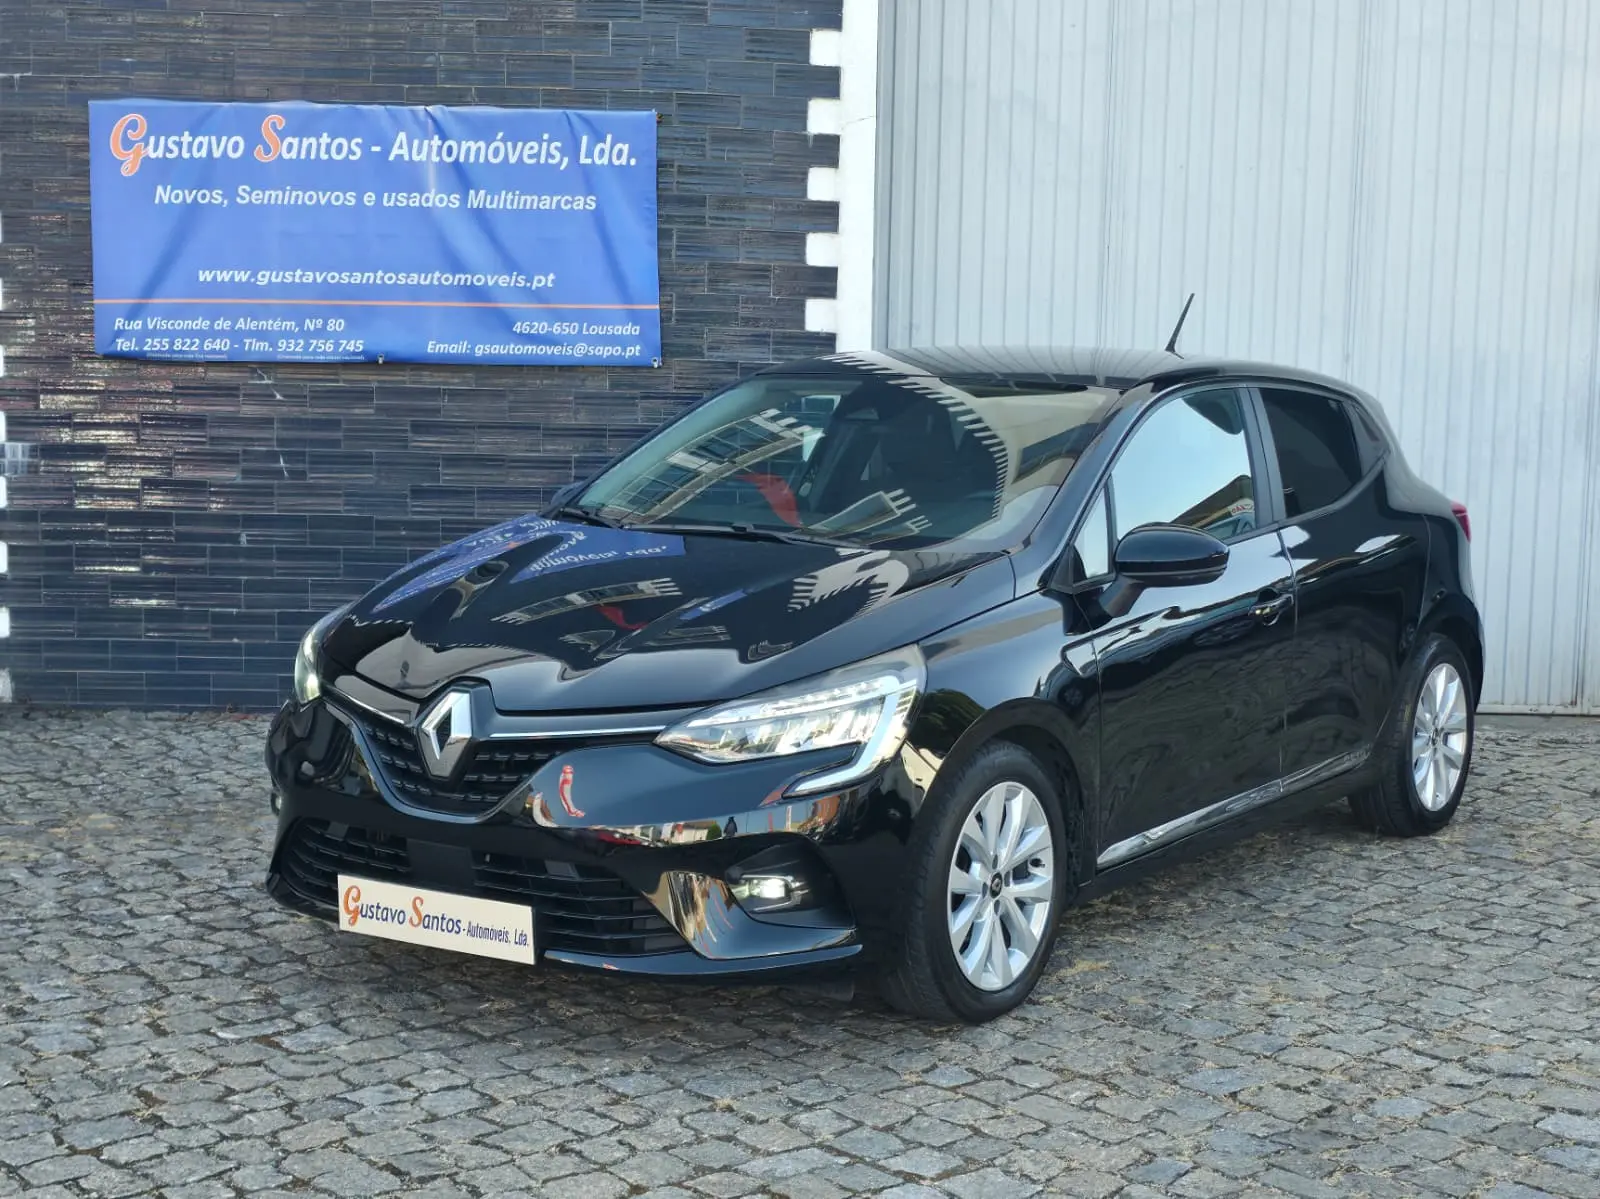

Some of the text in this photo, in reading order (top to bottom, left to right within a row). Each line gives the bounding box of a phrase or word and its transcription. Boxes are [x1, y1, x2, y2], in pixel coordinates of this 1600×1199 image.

[110, 113, 244, 176] Gustavo
[254, 114, 362, 162] Santos
[389, 131, 569, 170] Automóveis,
[579, 134, 637, 166] Lda.
[154, 184, 597, 210] Novos, Seminovos e usados Multimarcas
[198, 268, 556, 290] www.gustavosantosautomoveis.pt
[114, 317, 143, 330] Rua
[147, 317, 210, 331] Visconde
[214, 317, 231, 331] de
[235, 317, 299, 333] Alentém,
[327, 318, 345, 332] 80
[512, 321, 641, 335] 4620-650 Lousada
[116, 338, 138, 351] Tel.
[143, 338, 169, 351] 255
[173, 338, 200, 351] 822
[203, 338, 230, 351] 640
[243, 339, 273, 352] Tlm.
[277, 339, 304, 352] 932
[308, 339, 334, 352] 756
[338, 339, 364, 352] 745
[427, 340, 641, 359] Email: gsautomoveis@sapo.pt
[343, 885, 406, 927] Gustavo
[408, 896, 461, 935] Santos
[514, 929, 529, 946] Lda.
